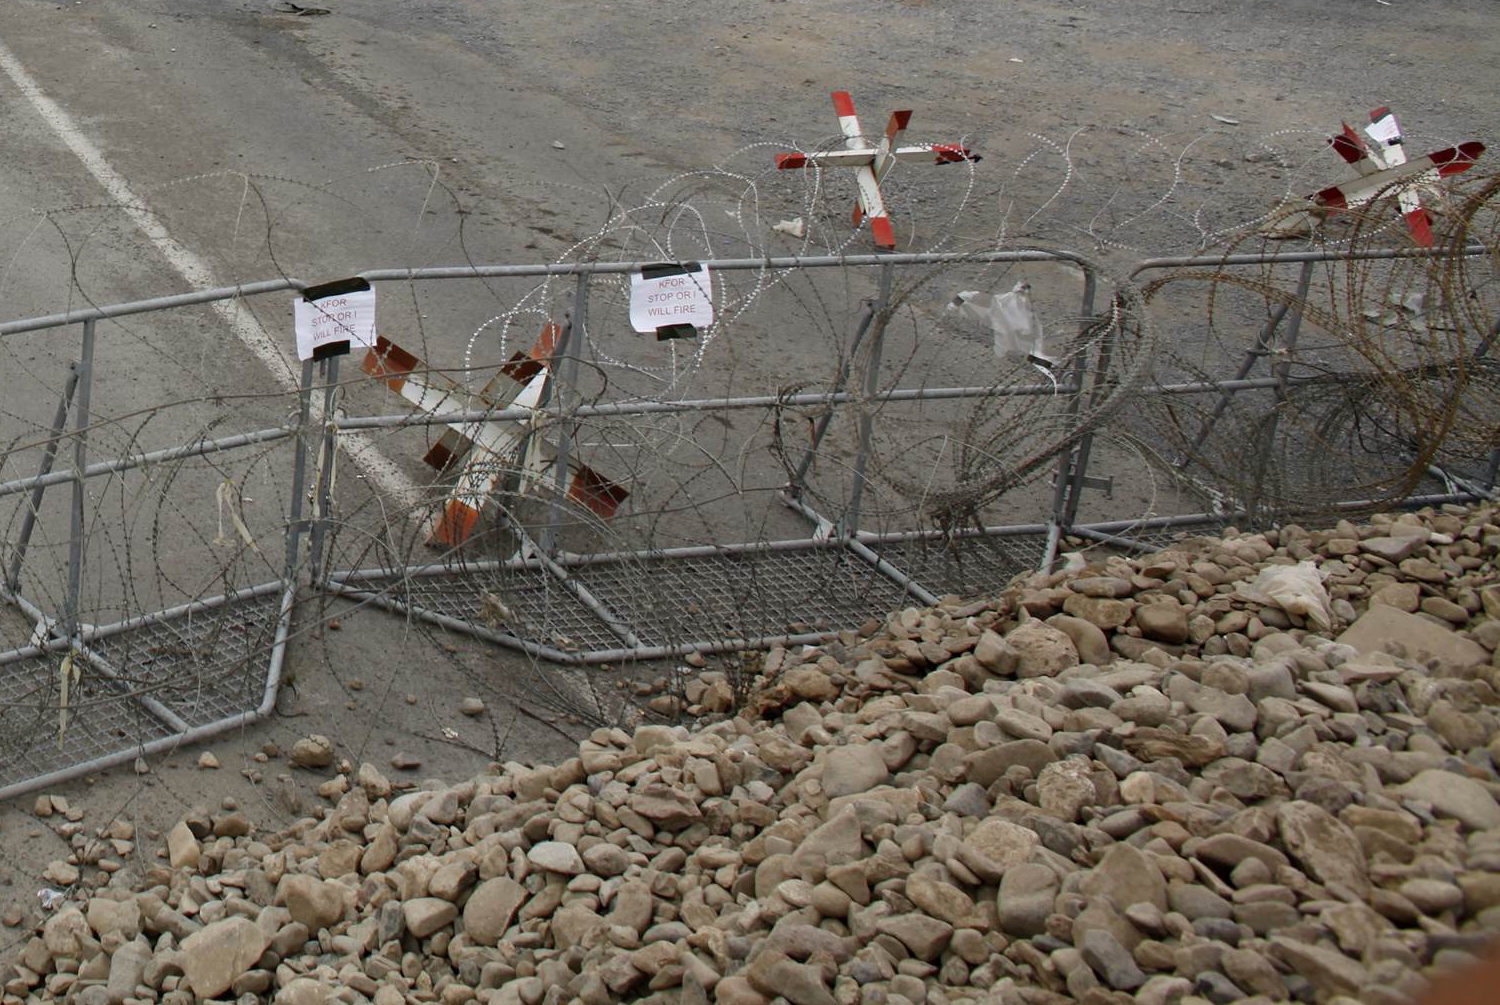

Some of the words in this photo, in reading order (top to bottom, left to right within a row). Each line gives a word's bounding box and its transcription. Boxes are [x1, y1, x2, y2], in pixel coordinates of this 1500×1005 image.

[659, 278, 685, 288] KFOR
[647, 292, 673, 304] STOP
[676, 290, 691, 300] OR
[320, 298, 347, 308] KFOR
[337, 311, 352, 321] OR
[648, 308, 671, 317] WILL
[673, 304, 696, 314] FIRE
[313, 330, 331, 341] WILL
[333, 323, 356, 336] FIRE
